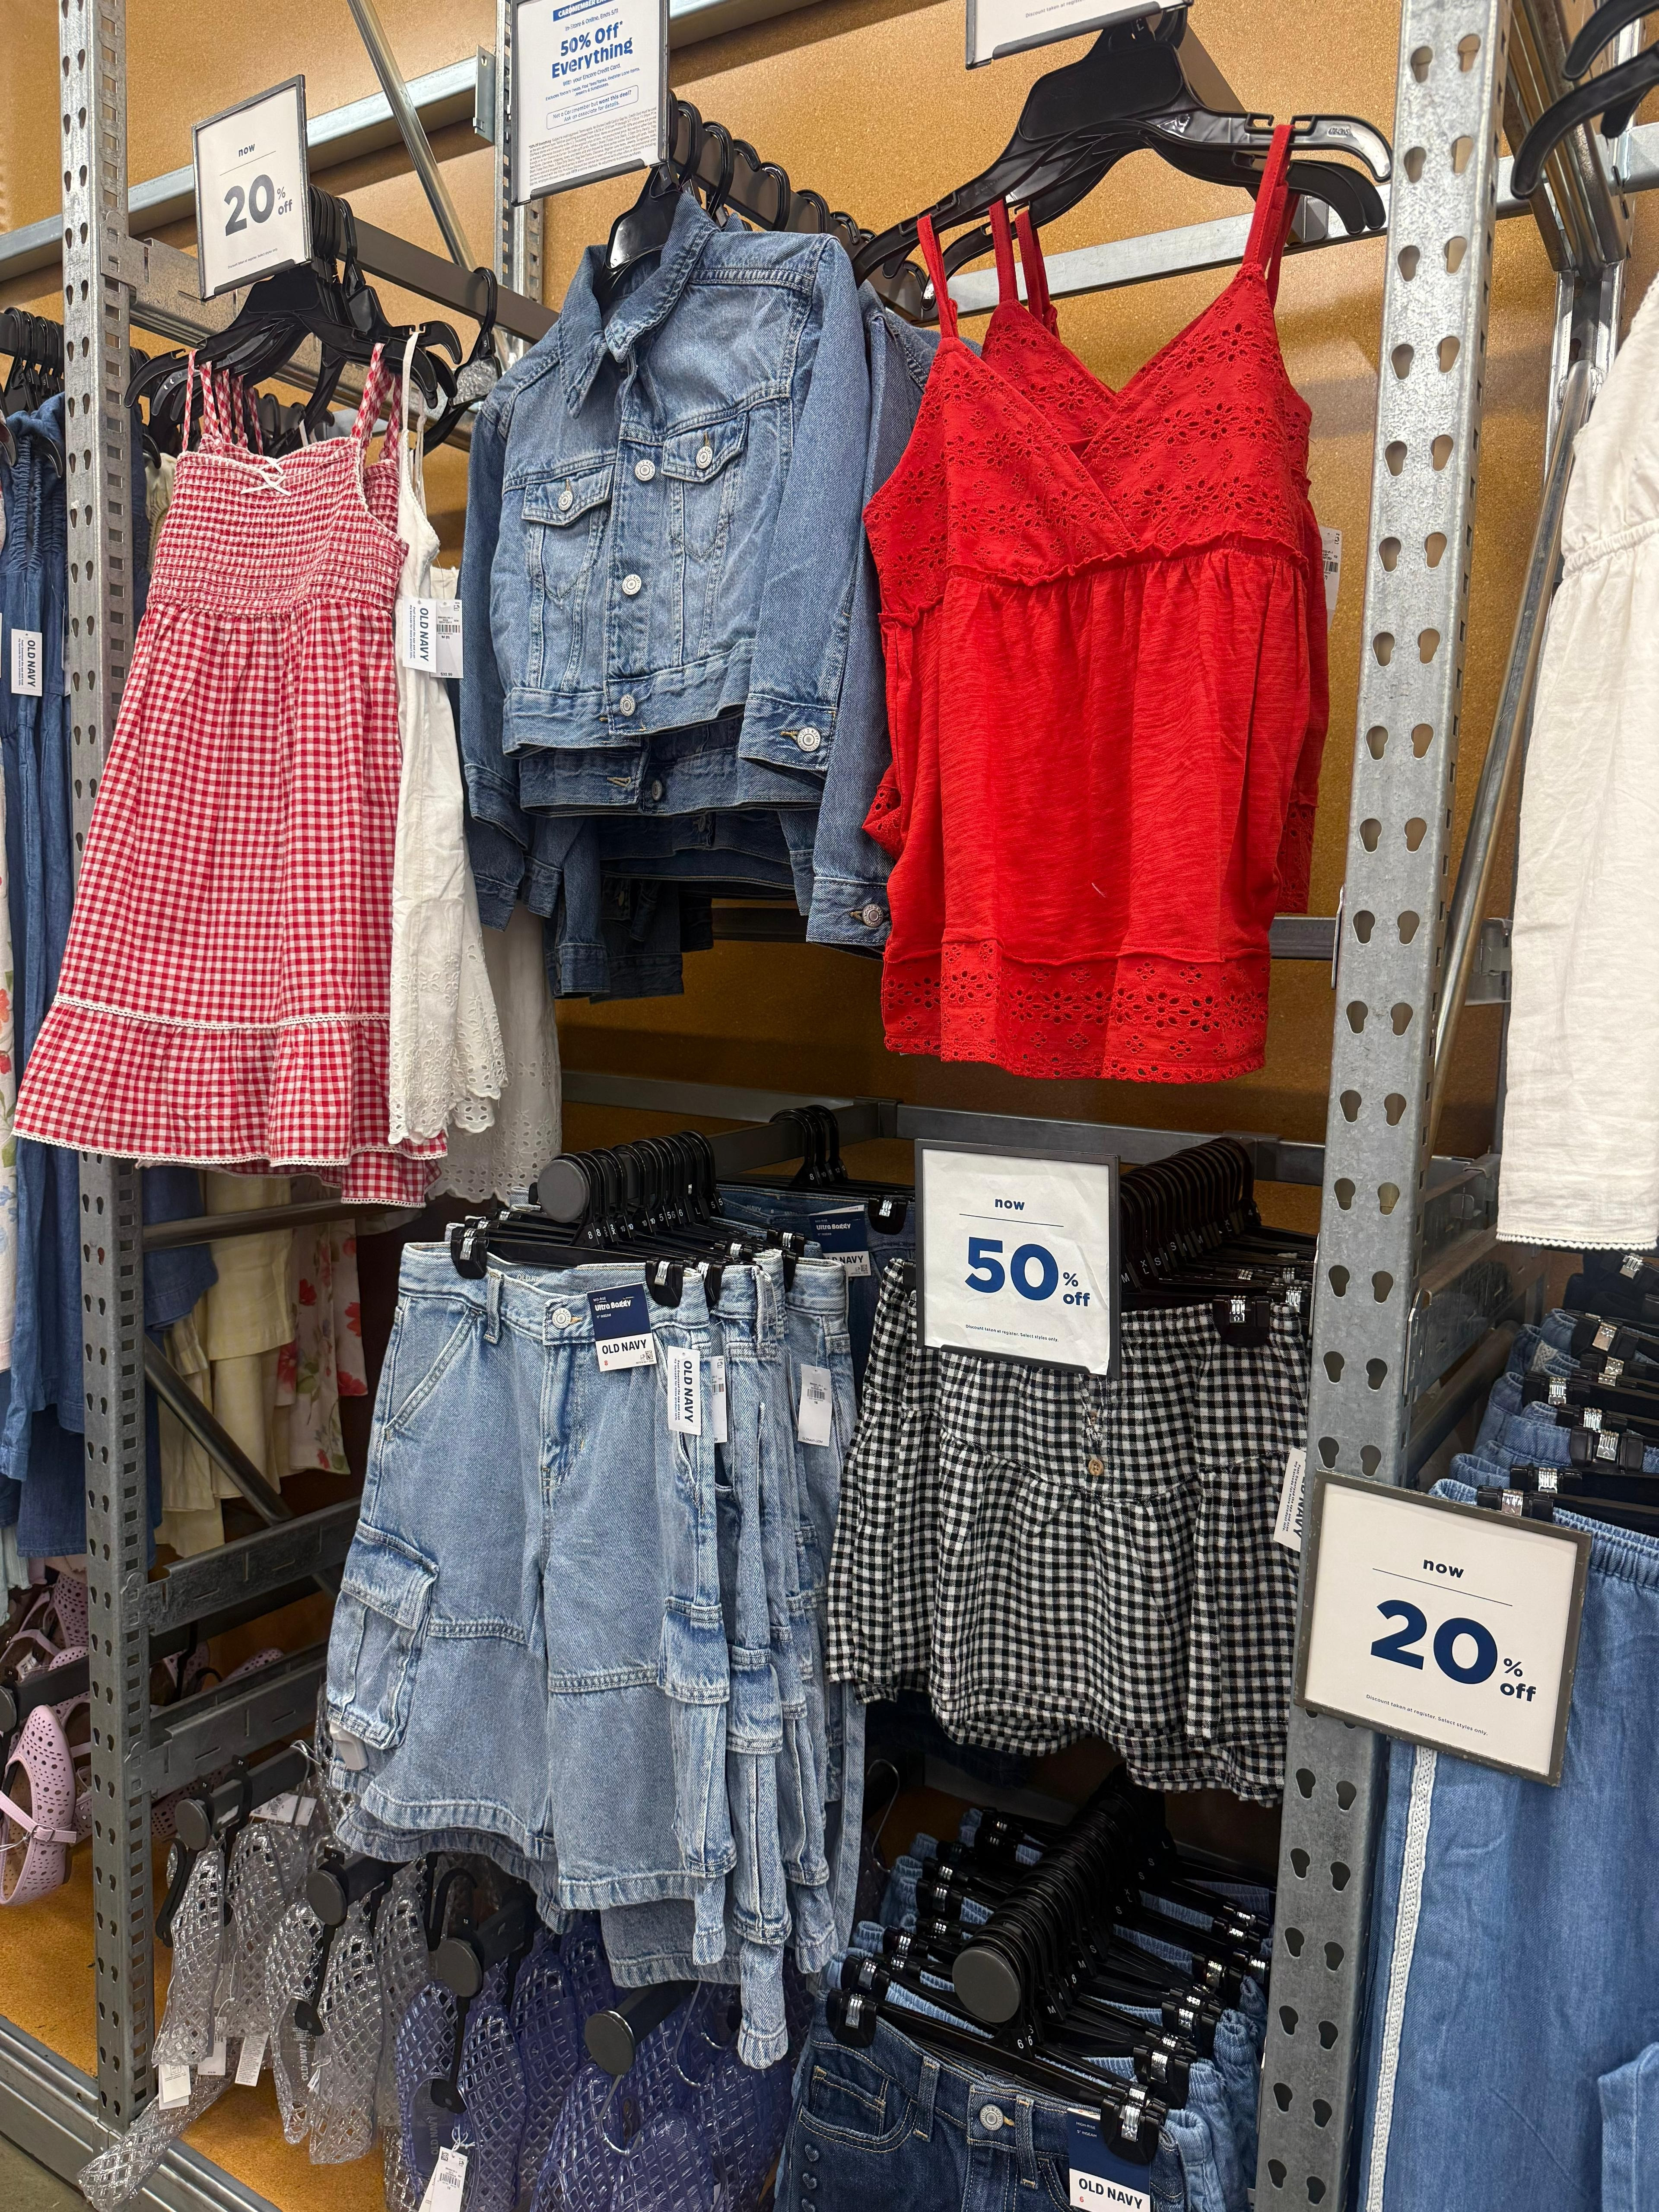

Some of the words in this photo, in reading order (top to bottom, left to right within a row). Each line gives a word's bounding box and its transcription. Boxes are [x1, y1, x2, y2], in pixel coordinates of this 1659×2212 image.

[558, 1, 596, 17] CARDMEMBER
[1025, 9, 1046, 18] Discount
[1046, 4, 1060, 12] taken
[565, 22, 581, 31] In-Store
[561, 32, 591, 56] 50%
[552, 37, 633, 79] Everything
[582, 71, 597, 79] Encore
[597, 67, 610, 76] Credit
[620, 89, 632, 98] deal?
[578, 108, 597, 118] associate
[238, 143, 255, 157] now
[278, 199, 292, 215] off
[420, 607, 429, 629] OLD
[27, 640, 35, 658] OLD
[420, 631, 429, 661] NAVY
[27, 661, 36, 687] NAVY
[718, 1198, 723, 1206] 5
[995, 1198, 1025, 1211] now
[667, 1211, 671, 1220] 5
[1170, 1242, 1177, 1251] S
[840, 1255, 864, 1265] NAVY
[1154, 1257, 1161, 1266] S
[1121, 1272, 1130, 1283] M
[594, 1303, 610, 1312] Ultra
[610, 1299, 632, 1309] Baggy
[1063, 1291, 1090, 1307] off
[602, 1343, 620, 1354] OLD
[621, 1339, 647, 1352] NAVY
[683, 1360, 693, 1385] OLD
[684, 1387, 693, 1423] NAVY
[1423, 1559, 1465, 1579] now
[1500, 1683, 1537, 1702] off
[1366, 1694, 1390, 1705] Discount
[1391, 1702, 1406, 1711] taken
[1414, 1710, 1437, 1720] register.
[1437, 1716, 1456, 1726] Select
[1456, 1722, 1473, 1731] styles
[1148, 1858, 1155, 1866] S
[1138, 1872, 1145, 1880] S
[1116, 1906, 1122, 1914] S
[1090, 1945, 1097, 1954] S
[1078, 1960, 1086, 1968] M
[1071, 1974, 1077, 1983] 8
[1047, 2006, 1056, 2014] M
[1017, 2039, 1024, 2049] 6
[1028, 2035, 1033, 2046] 6
[299, 2043, 308, 2064] NAVY
[992, 2107, 1002, 2117] NAVY
[1076, 2121, 1096, 2130] HIGH-RISE
[430, 2139, 439, 2155] OLD
[1079, 2178, 1104, 2195] OLD
[1107, 2187, 1143, 2209] NAVY
